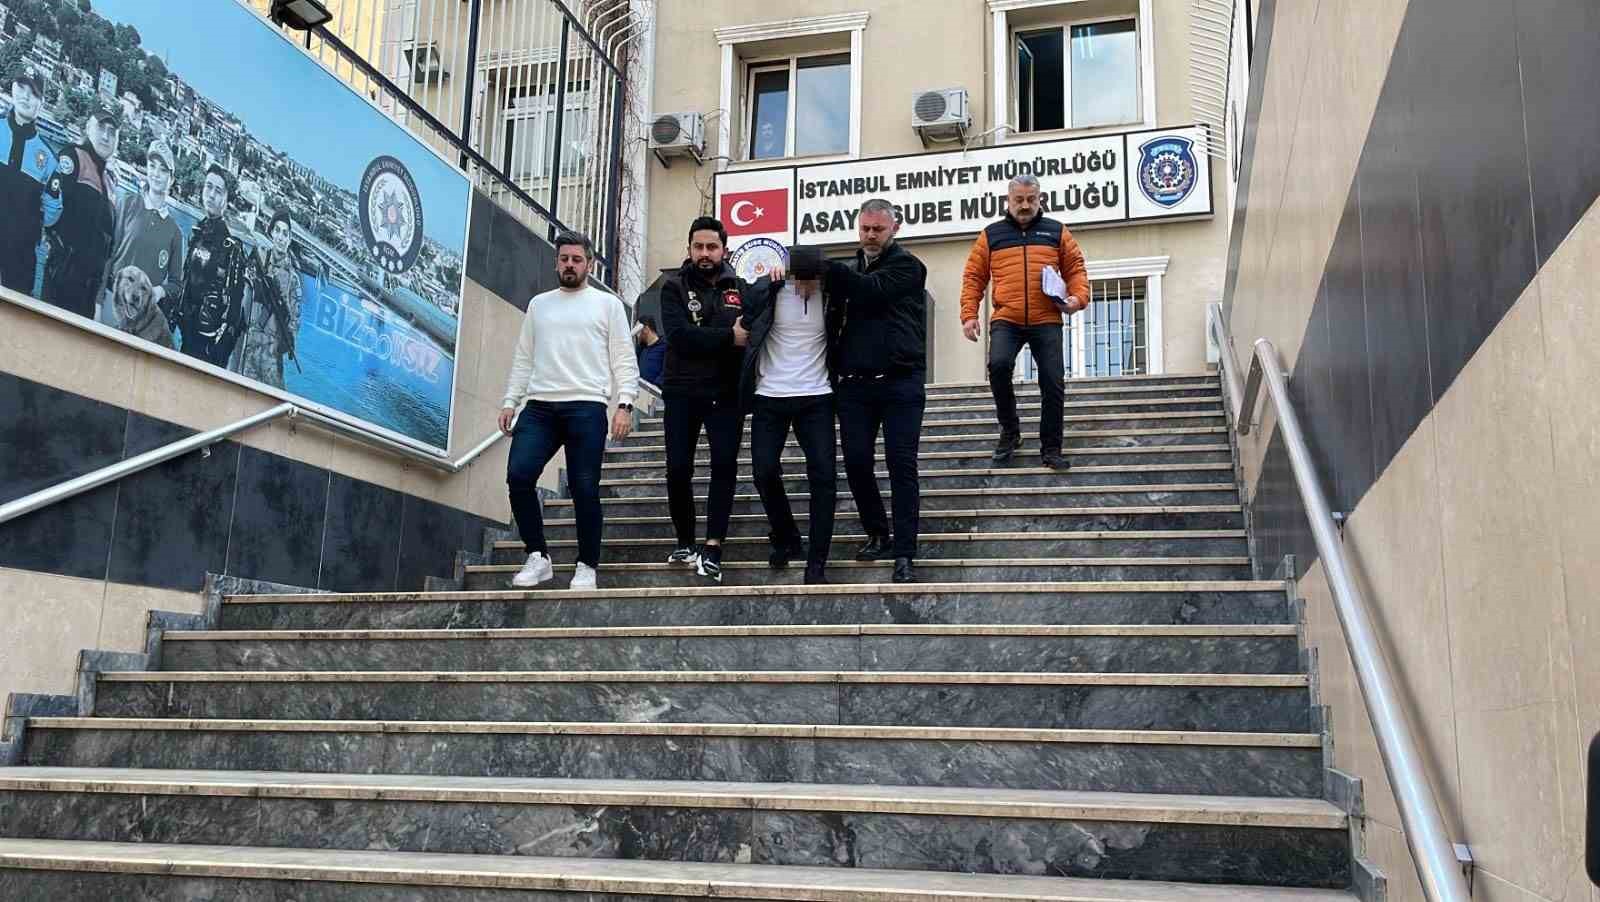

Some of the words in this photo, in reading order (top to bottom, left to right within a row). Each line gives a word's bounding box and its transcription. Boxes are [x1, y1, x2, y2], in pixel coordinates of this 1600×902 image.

[800, 177, 890, 200] İSTANBUL
[896, 166, 981, 190] EMNİYET
[988, 150, 1116, 181] MÜDÜRLÜĞÜ
[800, 208, 861, 234] ASAY
[961, 181, 1119, 220] MÜDRLÜĞÜ
